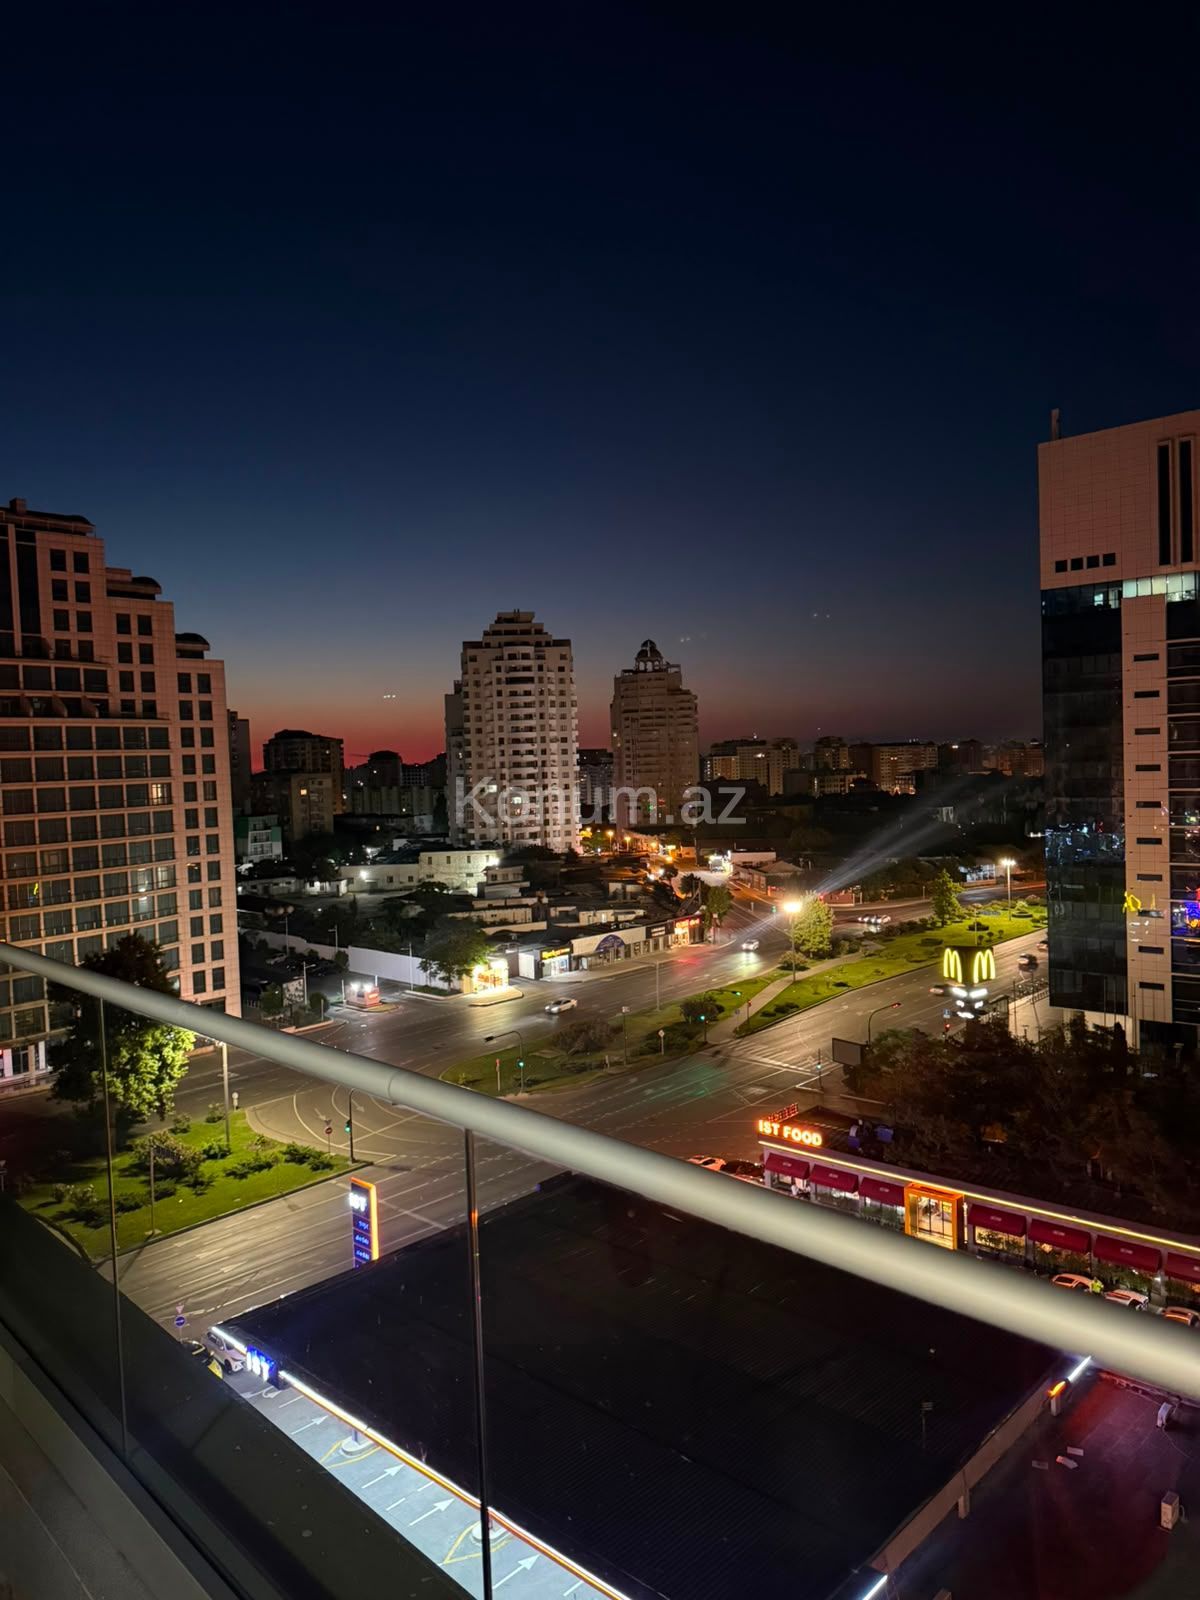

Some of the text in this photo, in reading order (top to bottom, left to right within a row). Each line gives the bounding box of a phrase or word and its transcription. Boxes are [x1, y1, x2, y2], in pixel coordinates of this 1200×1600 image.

[943, 948, 963, 984] M
[973, 949, 996, 984] M
[758, 1119, 823, 1146] IST FOOD
